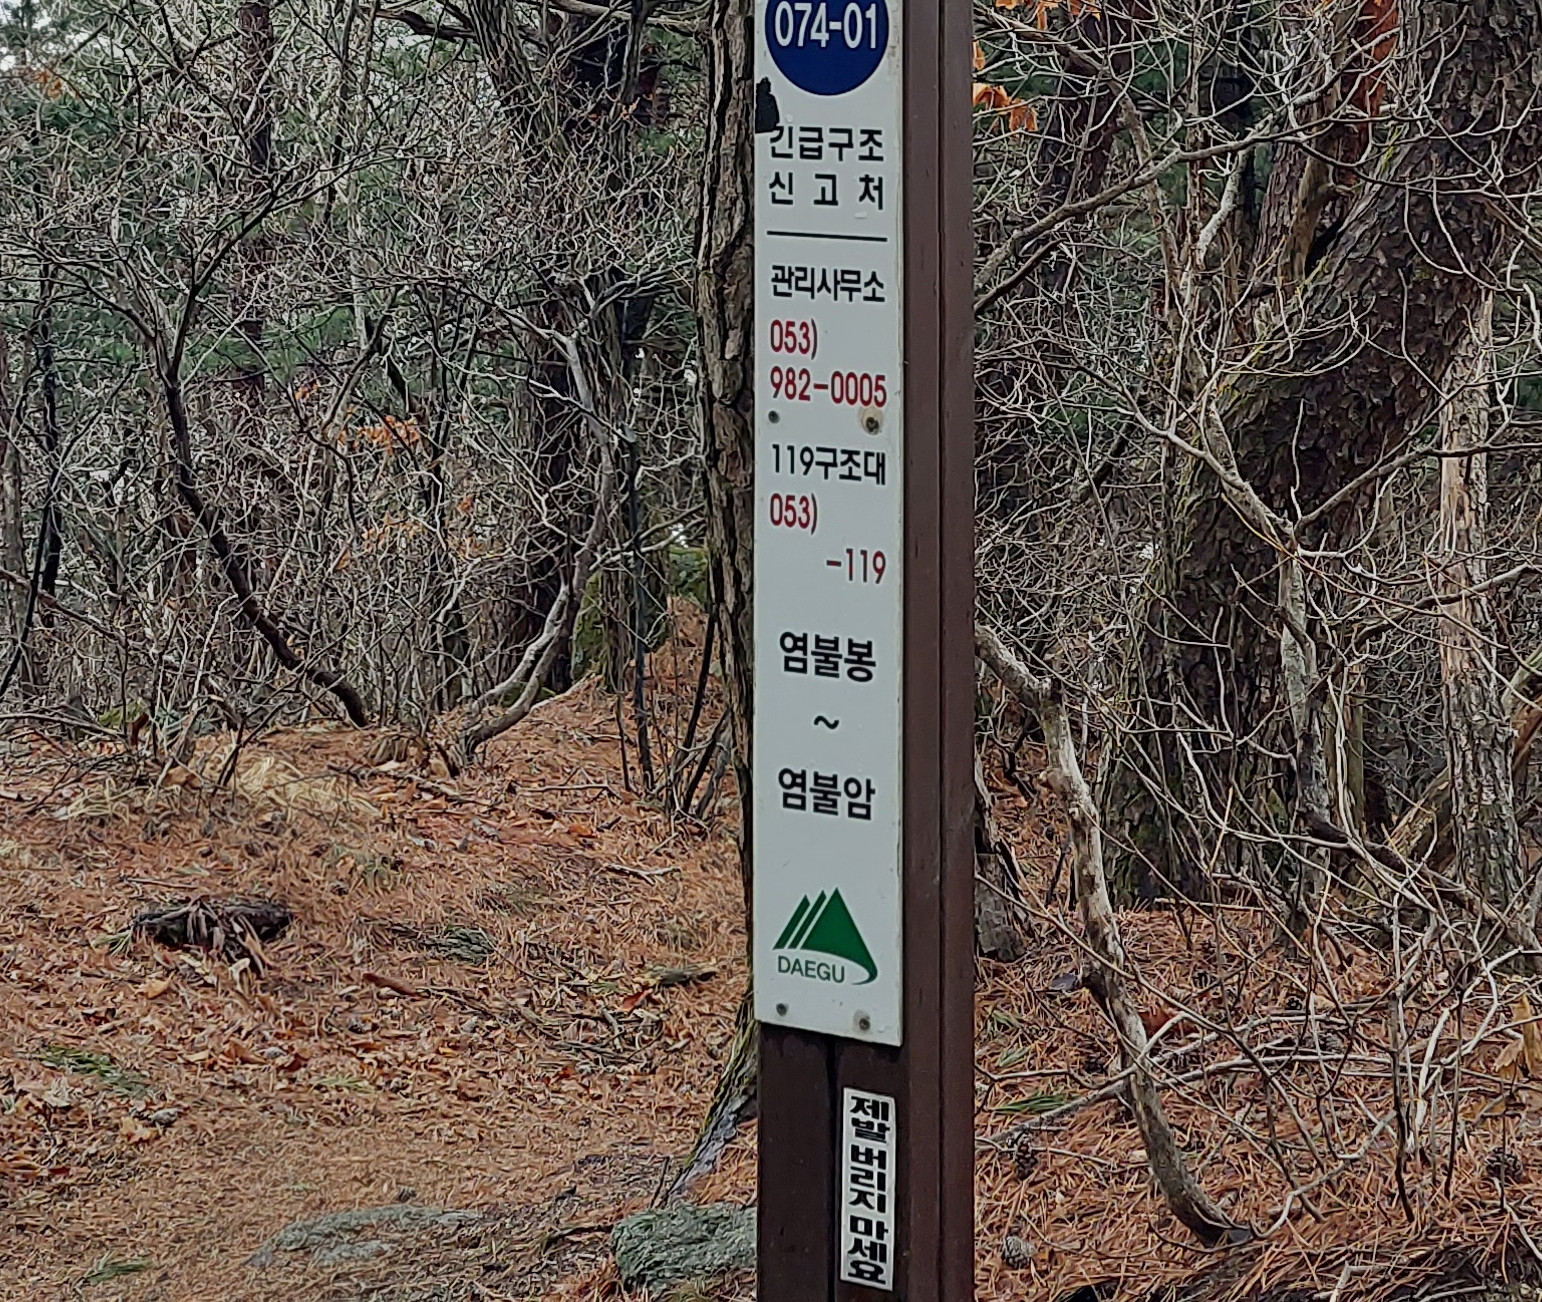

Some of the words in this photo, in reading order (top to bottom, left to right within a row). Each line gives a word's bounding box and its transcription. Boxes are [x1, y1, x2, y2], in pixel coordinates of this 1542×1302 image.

[774, 1, 877, 49] 074-01
[770, 125, 885, 162] 긴급구조
[771, 264, 886, 303] 관리사무소
[770, 318, 818, 360] 053)
[770, 365, 887, 408] 982-0005
[772, 443, 886, 486] 119구조대
[770, 492, 818, 535] 053)
[825, 548, 886, 585] -119
[779, 631, 877, 683] 염불봉
[777, 767, 876, 821] 염불암
[777, 955, 846, 984] DAEGU
